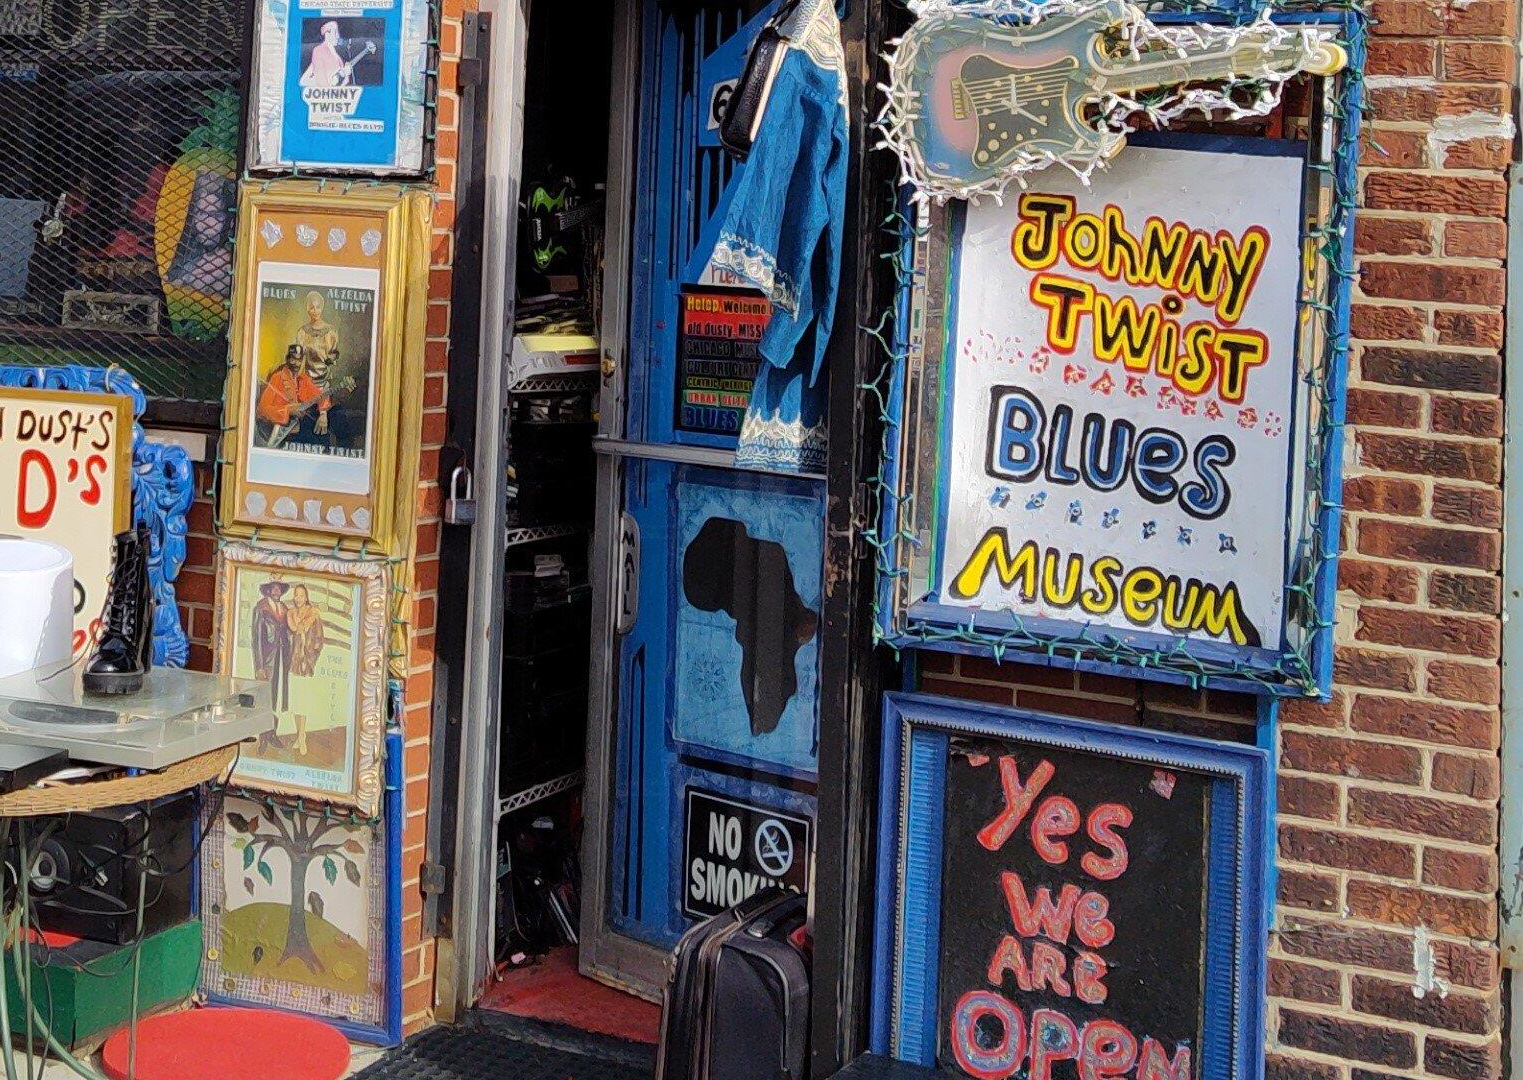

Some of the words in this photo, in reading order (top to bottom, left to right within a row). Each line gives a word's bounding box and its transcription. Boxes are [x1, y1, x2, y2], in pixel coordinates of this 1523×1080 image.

[305, 88, 358, 100] JOHNNY
[311, 102, 352, 113] TWIST
[262, 286, 297, 300] BLUES
[334, 300, 369, 313] TWIST
[687, 322, 702, 335] old
[684, 406, 739, 431] BLUES
[329, 445, 365, 459] TWIST
[622, 530, 635, 615] MAIL
[708, 811, 743, 861] NO
